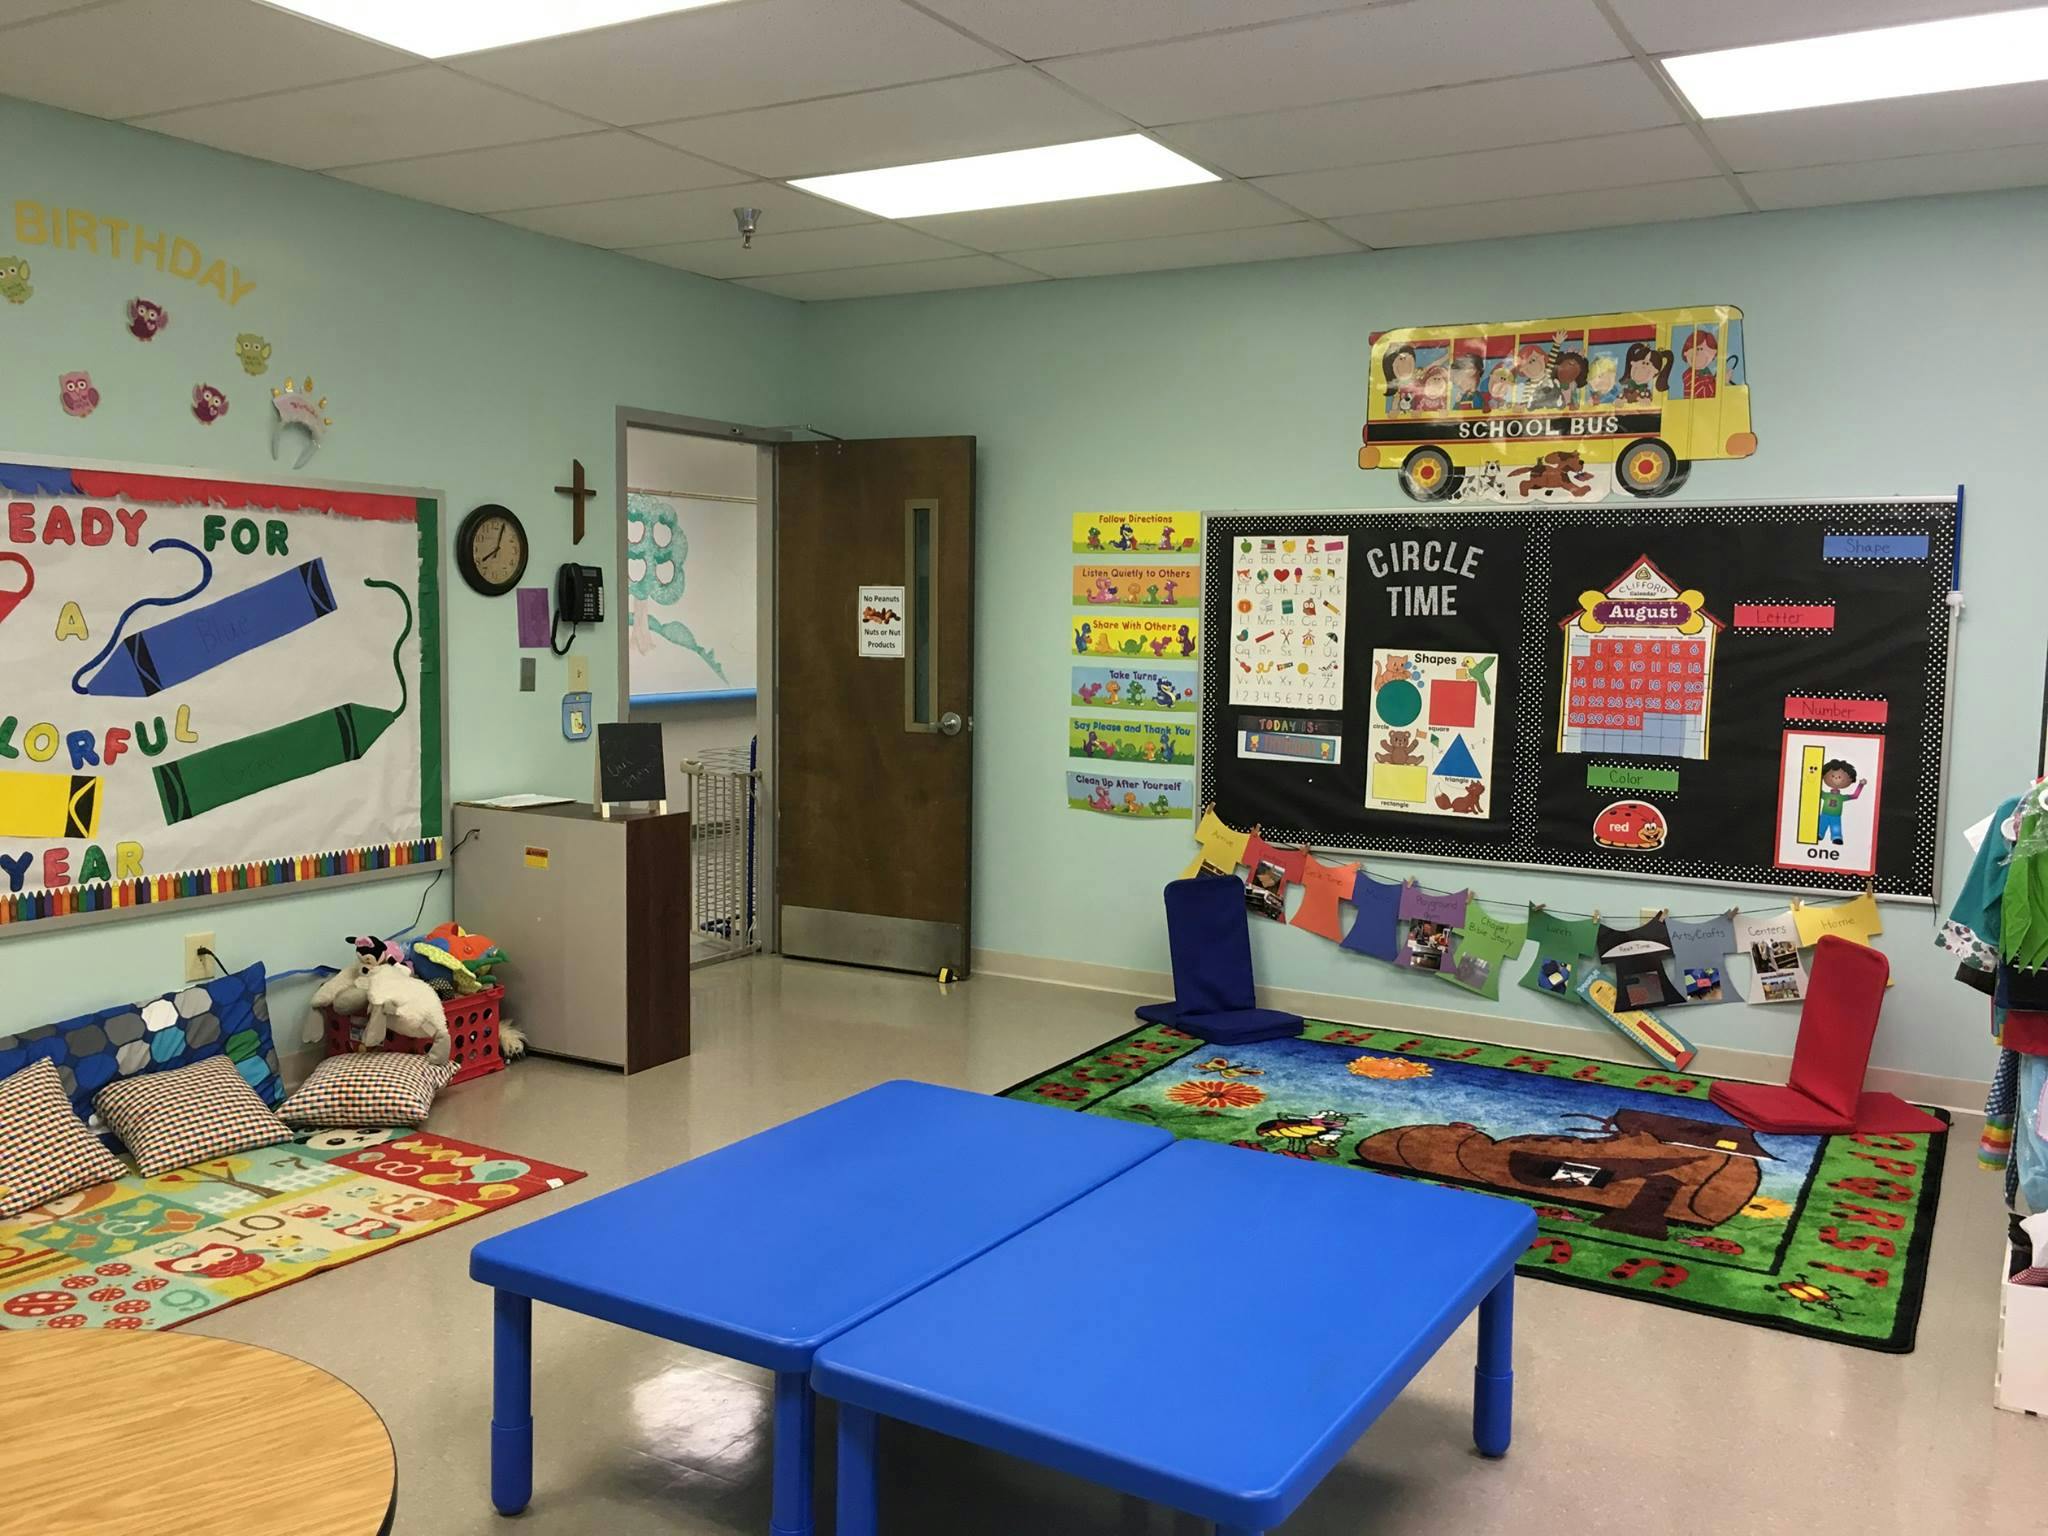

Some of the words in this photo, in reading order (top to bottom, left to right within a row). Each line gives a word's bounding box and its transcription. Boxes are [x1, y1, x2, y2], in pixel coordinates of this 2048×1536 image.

[15, 201, 256, 306] BIRTHDAY
[1459, 419, 1560, 438] SCHOOL
[1570, 417, 1618, 434] BUS
[1099, 515, 1125, 523] Follow
[1129, 515, 1172, 523] Directions
[203, 514, 289, 556] FOR
[1847, 538, 1890, 555] Shape
[1262, 554, 1275, 564] Bb
[1305, 554, 1318, 564] Dd
[1327, 554, 1341, 564] Ee
[1367, 540, 1484, 579] CIRCLE
[1082, 568, 1108, 577] Listen
[1112, 569, 1143, 579] Quietly
[1158, 570, 1190, 578] Others
[1619, 581, 1667, 594] CLIFFORD
[1386, 585, 1457, 616] TIME
[1609, 605, 1677, 621] August
[1756, 608, 1803, 624] Letter
[55, 600, 89, 641] A
[1093, 620, 1118, 629] Share
[1122, 621, 1141, 630] With
[1144, 622, 1176, 630] Others
[1598, 644, 1602, 653] 1
[1615, 644, 1623, 653] 2
[1634, 644, 1642, 654] 3
[1652, 644, 1661, 654] 4
[1671, 644, 1680, 654] 5
[1690, 645, 1698, 654] 6
[1415, 653, 1457, 665] Shapes
[1577, 661, 1584, 670] 7
[1595, 661, 1603, 671] 8
[1614, 661, 1622, 671] 9
[1630, 662, 1645, 672] 10
[1652, 662, 1660, 672] 11
[1668, 663, 1681, 672] 12
[1688, 663, 1700, 673] 13
[1110, 670, 1129, 679] Take
[1133, 672, 1157, 681] Turns
[1573, 679, 1586, 688] 14
[1593, 679, 1605, 688] 15
[1611, 679, 1624, 689] 16
[1631, 679, 1643, 689] 17
[1649, 680, 1660, 690] 18
[1668, 682, 1680, 692] 19
[1684, 682, 1704, 692] 20
[1572, 696, 1585, 706] 21
[1588, 696, 1604, 707] 22
[1626, 698, 1642, 708] 24
[1645, 699, 1661, 708] 25
[1665, 700, 1681, 710] 26
[1685, 699, 1702, 710] 27
[1802, 701, 1855, 718] Number
[1259, 719, 1296, 731] TODAY
[1570, 714, 1585, 723] 28
[1588, 714, 1604, 724] 29
[1605, 714, 1624, 725] 30
[1628, 716, 1639, 726] 31
[1074, 721, 1090, 731] Say
[1093, 722, 1121, 732] Please
[1144, 725, 1171, 734] Thank
[1175, 727, 1190, 736] You
[1076, 775, 1100, 785] Clean
[1102, 778, 1113, 788] Up
[1116, 780, 1139, 789] After
[1142, 780, 1181, 790] Yourself
[1610, 770, 1643, 784] Color
[1609, 822, 1629, 832] red
[1807, 848, 1840, 860] one
[0, 841, 144, 892] YEAR
[1748, 925, 1786, 936] Centers
[1821, 918, 1856, 930] Home
[1672, 928, 1726, 940] Arts/Crafts
[374, 1161, 424, 1176] 8
[96, 1219, 150, 1236] 6
[208, 1215, 286, 1242] 10
[160, 1289, 210, 1312] 9
